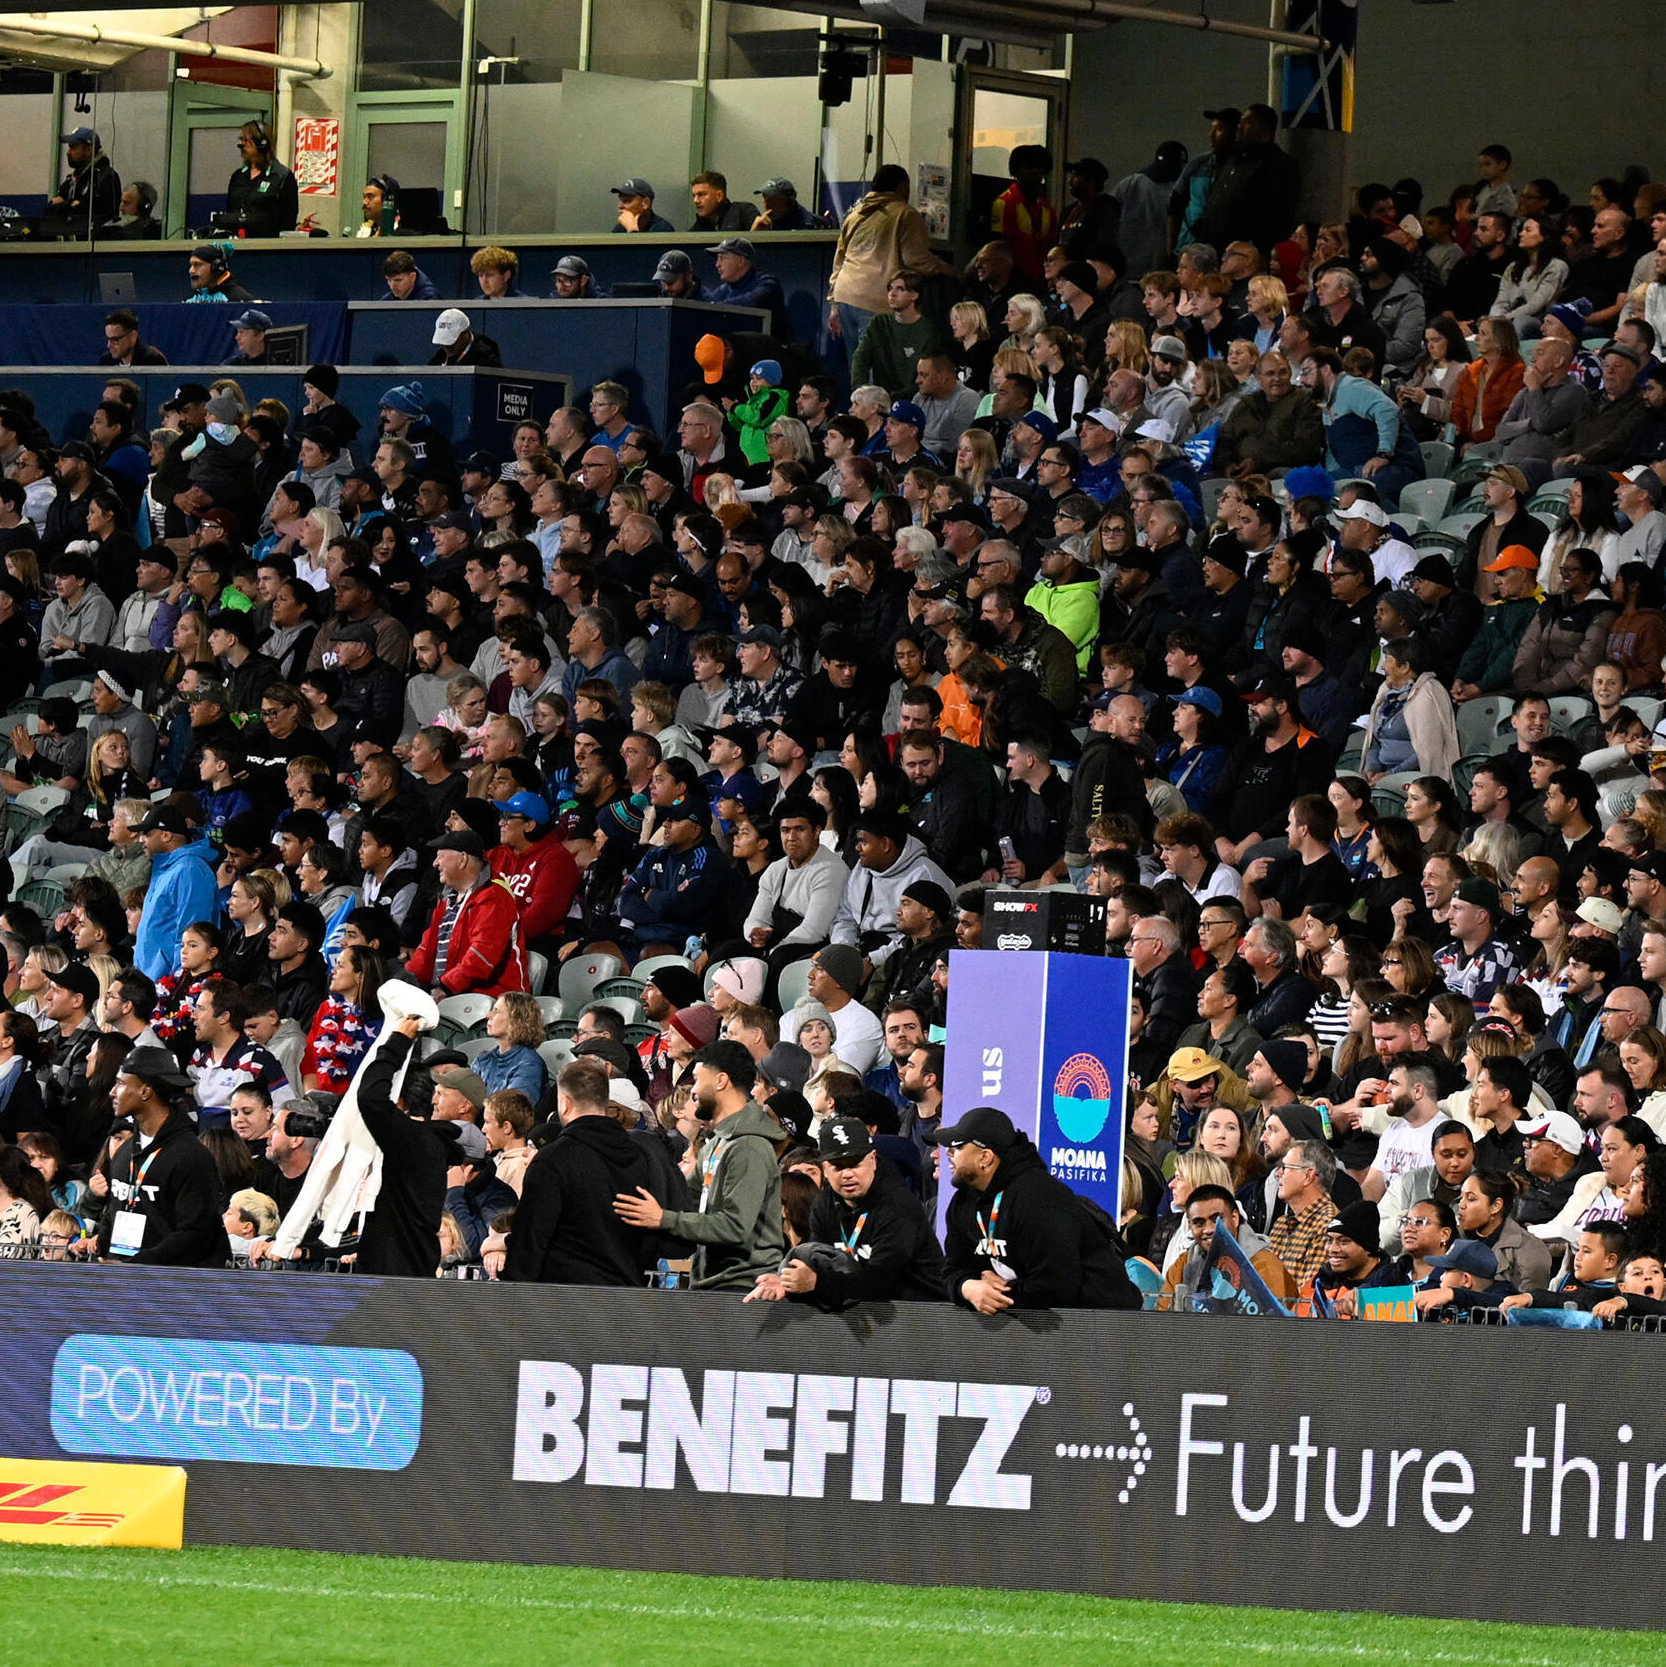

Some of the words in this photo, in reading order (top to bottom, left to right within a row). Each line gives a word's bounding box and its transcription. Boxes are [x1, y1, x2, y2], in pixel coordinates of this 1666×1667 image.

[503, 393, 528, 405] MEDIA
[504, 405, 526, 416] ONLY
[993, 901, 1037, 913] SHOWFX
[982, 1048, 1003, 1097] us
[1051, 1148, 1106, 1170] MOANA
[1051, 1167, 1106, 1182] PASIFIKA
[77, 1364, 318, 1433] POWERED
[334, 1378, 386, 1449] By
[513, 1359, 1037, 1510] BENEFITZ
[1176, 1394, 1474, 1532] Future
